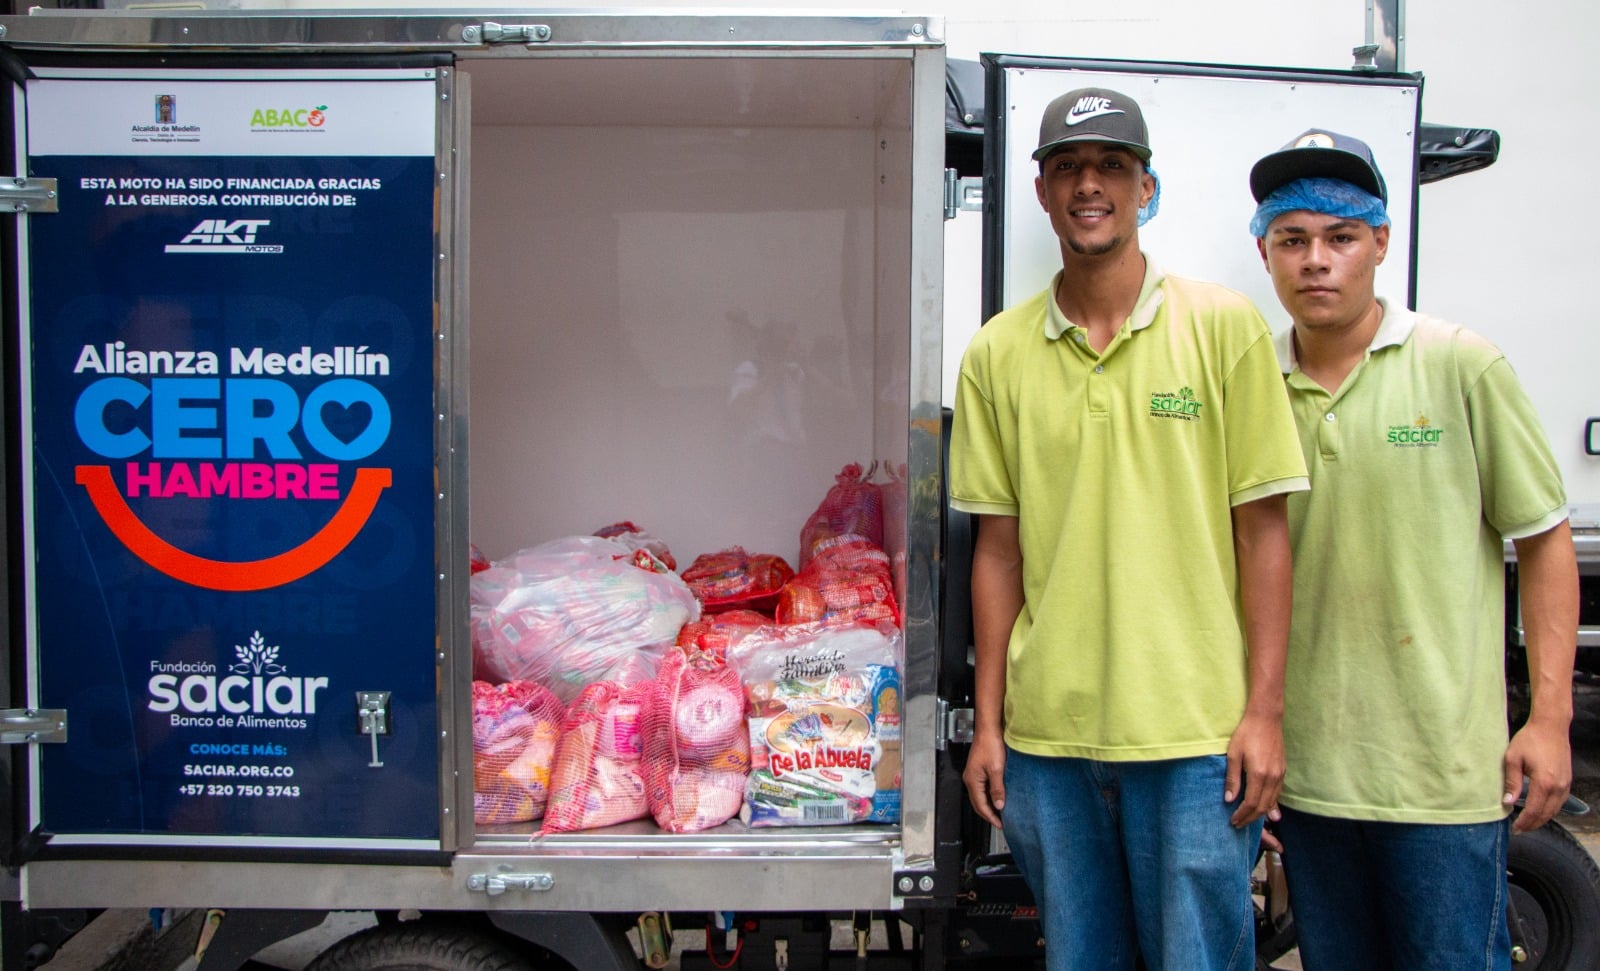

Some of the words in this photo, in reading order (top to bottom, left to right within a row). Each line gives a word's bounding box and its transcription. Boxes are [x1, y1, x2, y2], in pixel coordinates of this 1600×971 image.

[1073, 97, 1111, 113] NIKE
[250, 109, 325, 127] ABACO
[80, 178, 117, 190] ESTA
[120, 178, 162, 190] MOTO
[165, 178, 186, 190] HA
[189, 178, 224, 190] SIDO
[227, 178, 315, 190] FINANCIADA
[318, 178, 381, 190] GRACIAS
[105, 194, 116, 206] A
[119, 194, 138, 206] LA
[141, 194, 218, 206] GENEROSA
[221, 192, 329, 206] CONTRIBUCIÓN
[332, 194, 357, 206] DE:
[180, 219, 270, 243] AKT
[73, 341, 219, 375] Alianza
[230, 346, 390, 376] Medellín
[74, 377, 391, 461] CERO
[1387, 429, 1444, 443] saciar
[126, 462, 340, 499] HAMBRE
[150, 661, 216, 673] Fundación
[148, 674, 329, 714] saciar
[170, 714, 214, 727] Banco
[216, 715, 234, 728] de
[237, 715, 307, 729] Alimentos
[190, 743, 250, 755] CONOCE
[252, 742, 288, 756] MÁS:
[794, 749, 812, 771] la
[815, 744, 872, 771] Abuela
[183, 764, 294, 777] SACIAR.ORG.CO
[179, 784, 205, 796] +57
[207, 784, 234, 796] 320
[236, 785, 264, 797] 750
[266, 785, 300, 798] 3743
